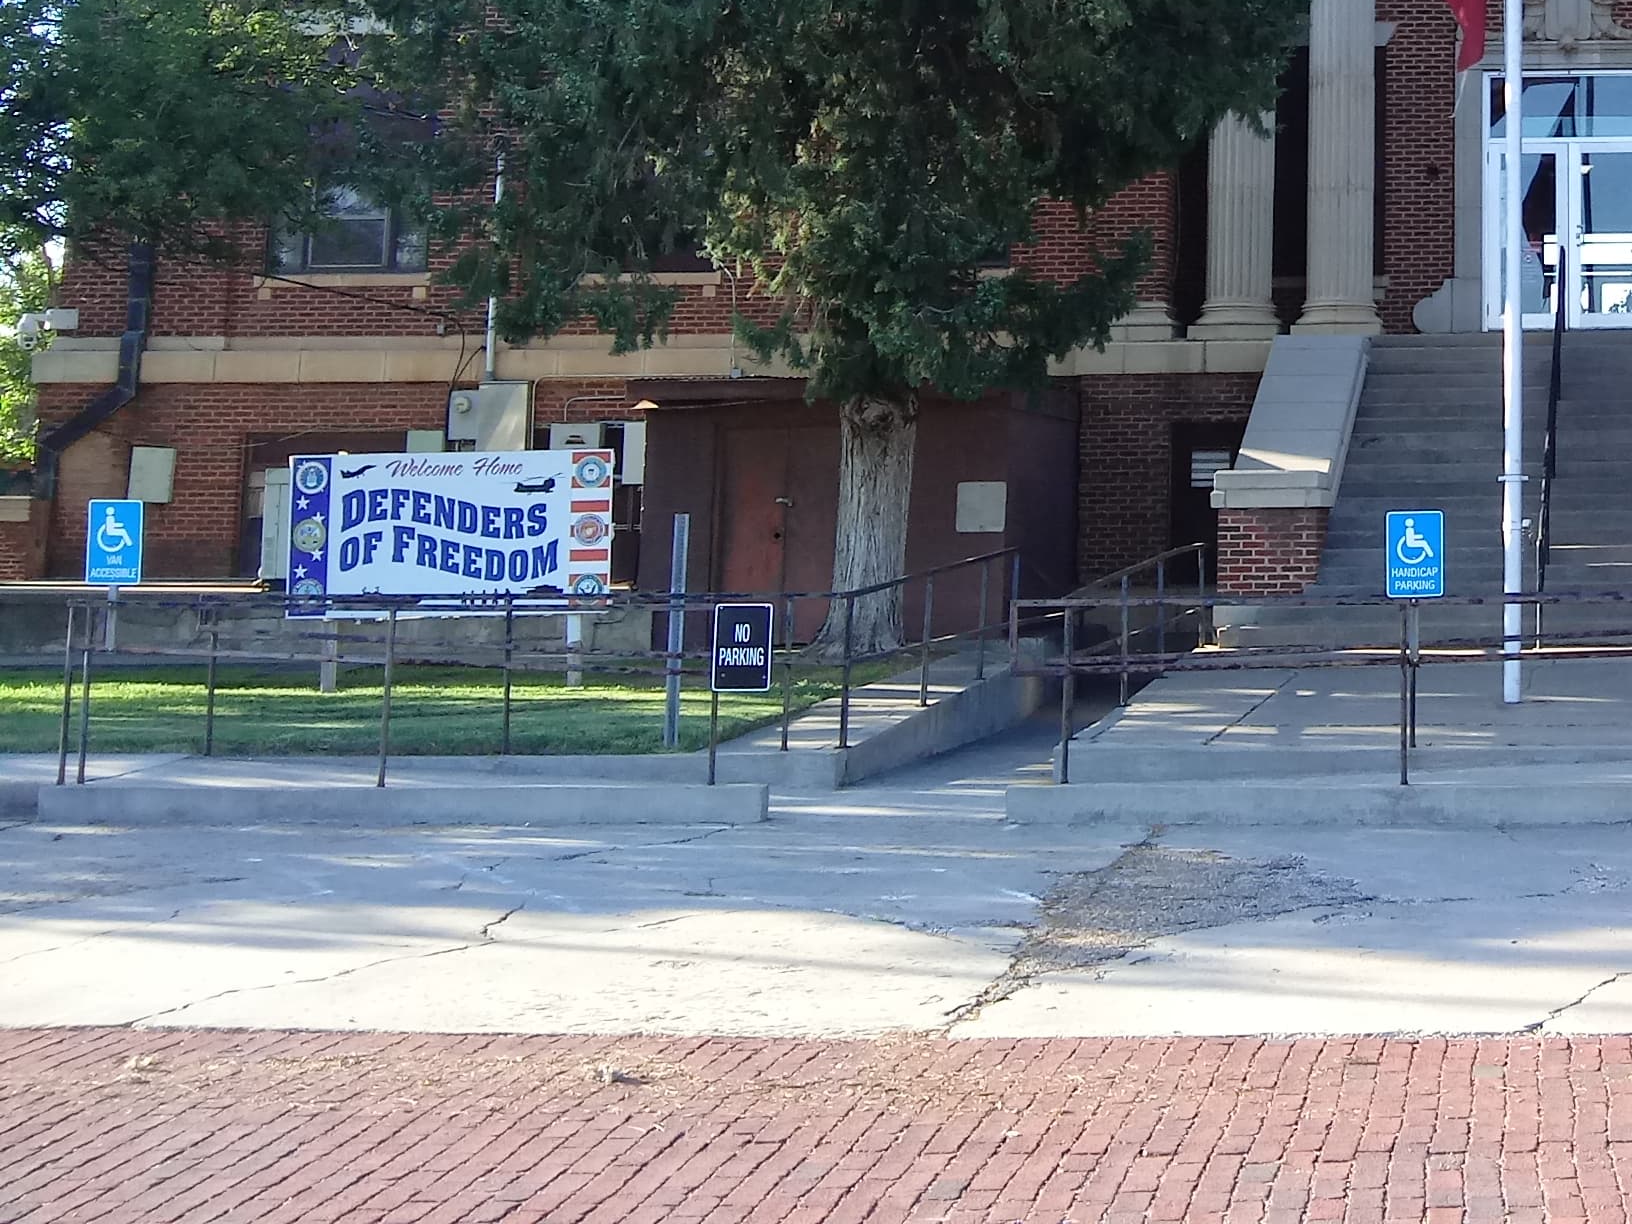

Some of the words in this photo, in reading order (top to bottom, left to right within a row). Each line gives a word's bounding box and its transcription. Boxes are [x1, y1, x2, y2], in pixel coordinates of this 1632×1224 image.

[385, 458, 463, 478] Welcome
[472, 456, 523, 476] Home
[341, 488, 548, 540] DEFENDERS
[106, 554, 123, 566] VAN
[339, 531, 383, 572] OF
[392, 525, 559, 583] FREEDOM
[90, 567, 138, 579] ACCESSIBLE
[1391, 567, 1438, 577] HANDICAP
[1394, 580, 1436, 591] PARKING
[734, 623, 751, 643] NO
[719, 647, 764, 666] PARKING
